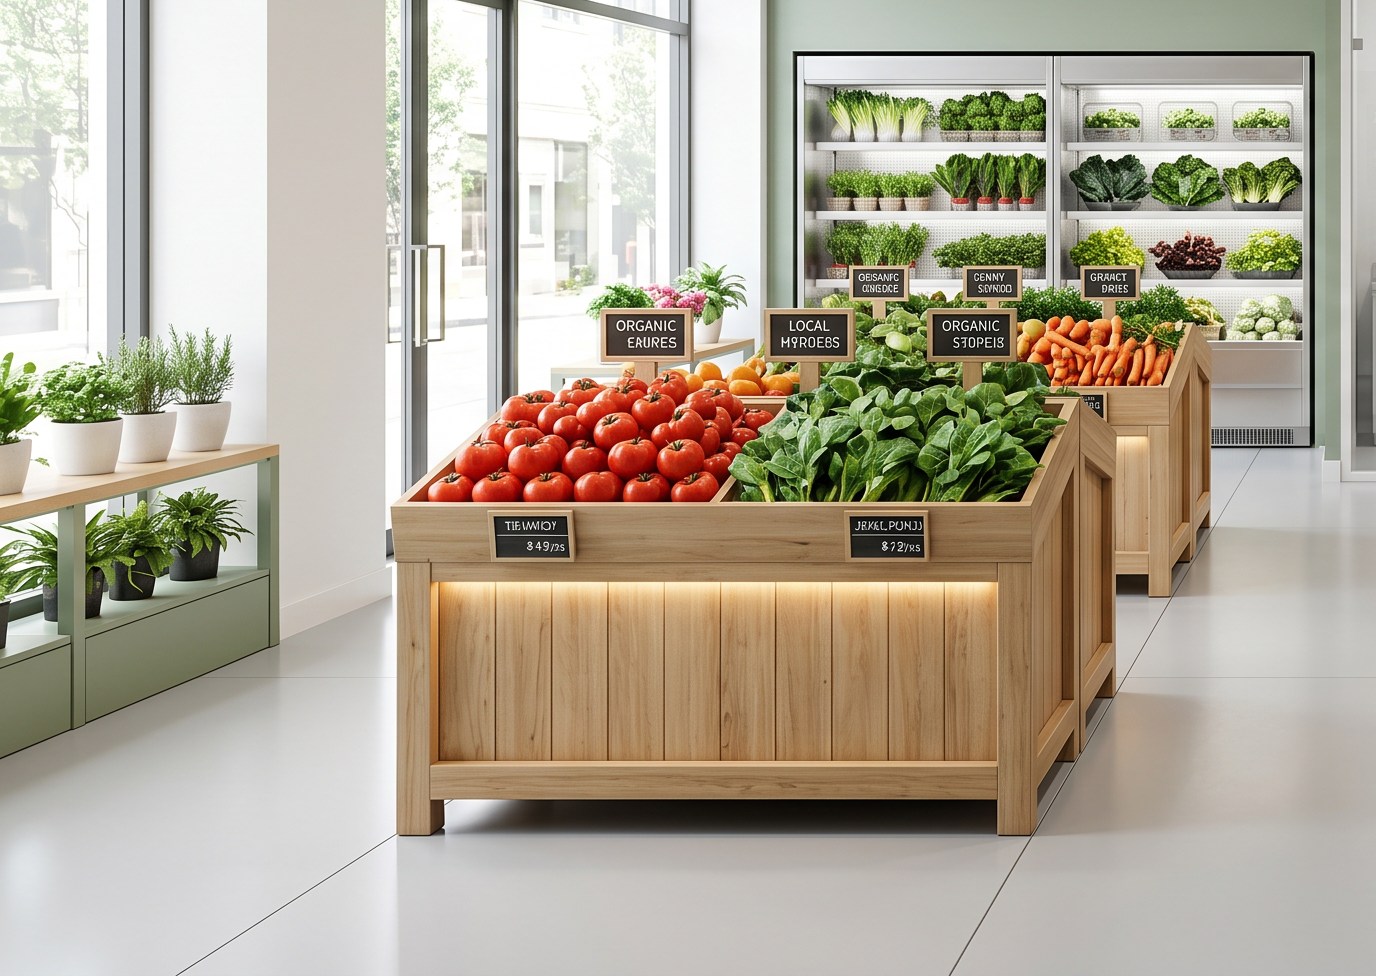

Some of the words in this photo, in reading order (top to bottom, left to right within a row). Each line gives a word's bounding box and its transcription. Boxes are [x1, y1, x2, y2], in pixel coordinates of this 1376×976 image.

[616, 320, 677, 332] ORGANIC
[789, 320, 830, 332] LOCAL
[942, 320, 1000, 332] ORGANIC
